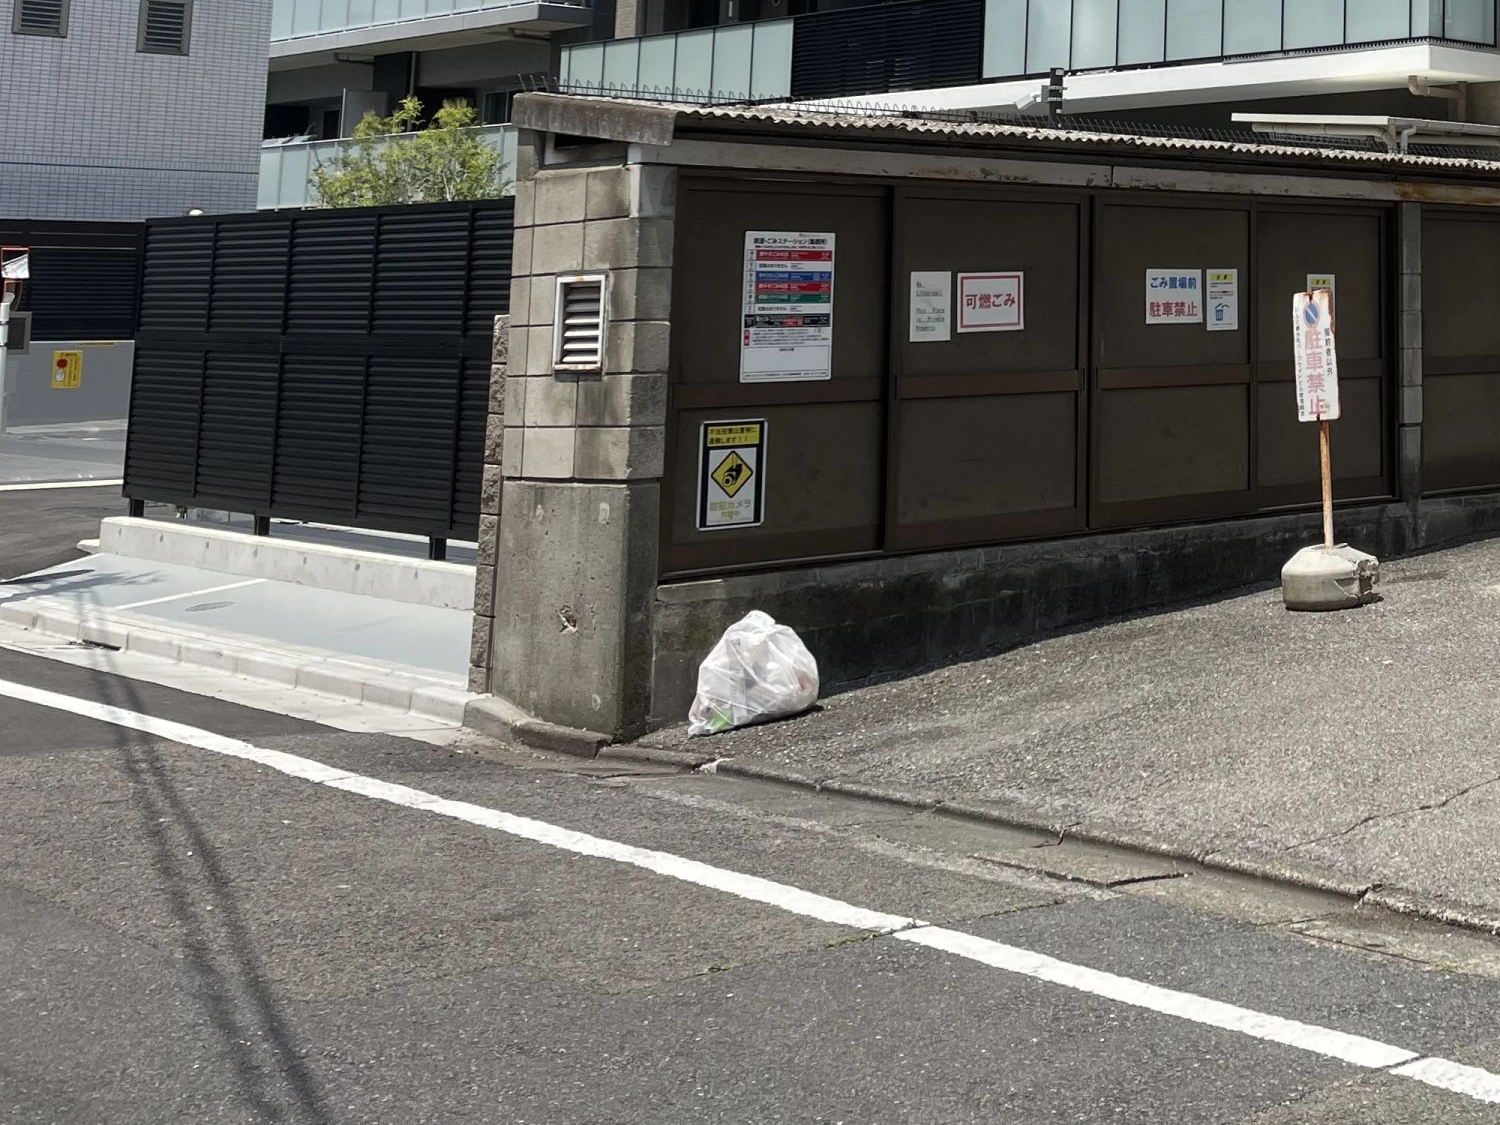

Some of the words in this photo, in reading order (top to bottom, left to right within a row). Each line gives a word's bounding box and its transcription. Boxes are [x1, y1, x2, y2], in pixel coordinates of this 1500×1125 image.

[1150, 276, 1197, 290] ごみ置場前
[964, 292, 1016, 310] 可燃ごみ
[1149, 300, 1198, 318] 駐車禁止
[1304, 329, 1327, 416] 駐車禁止
